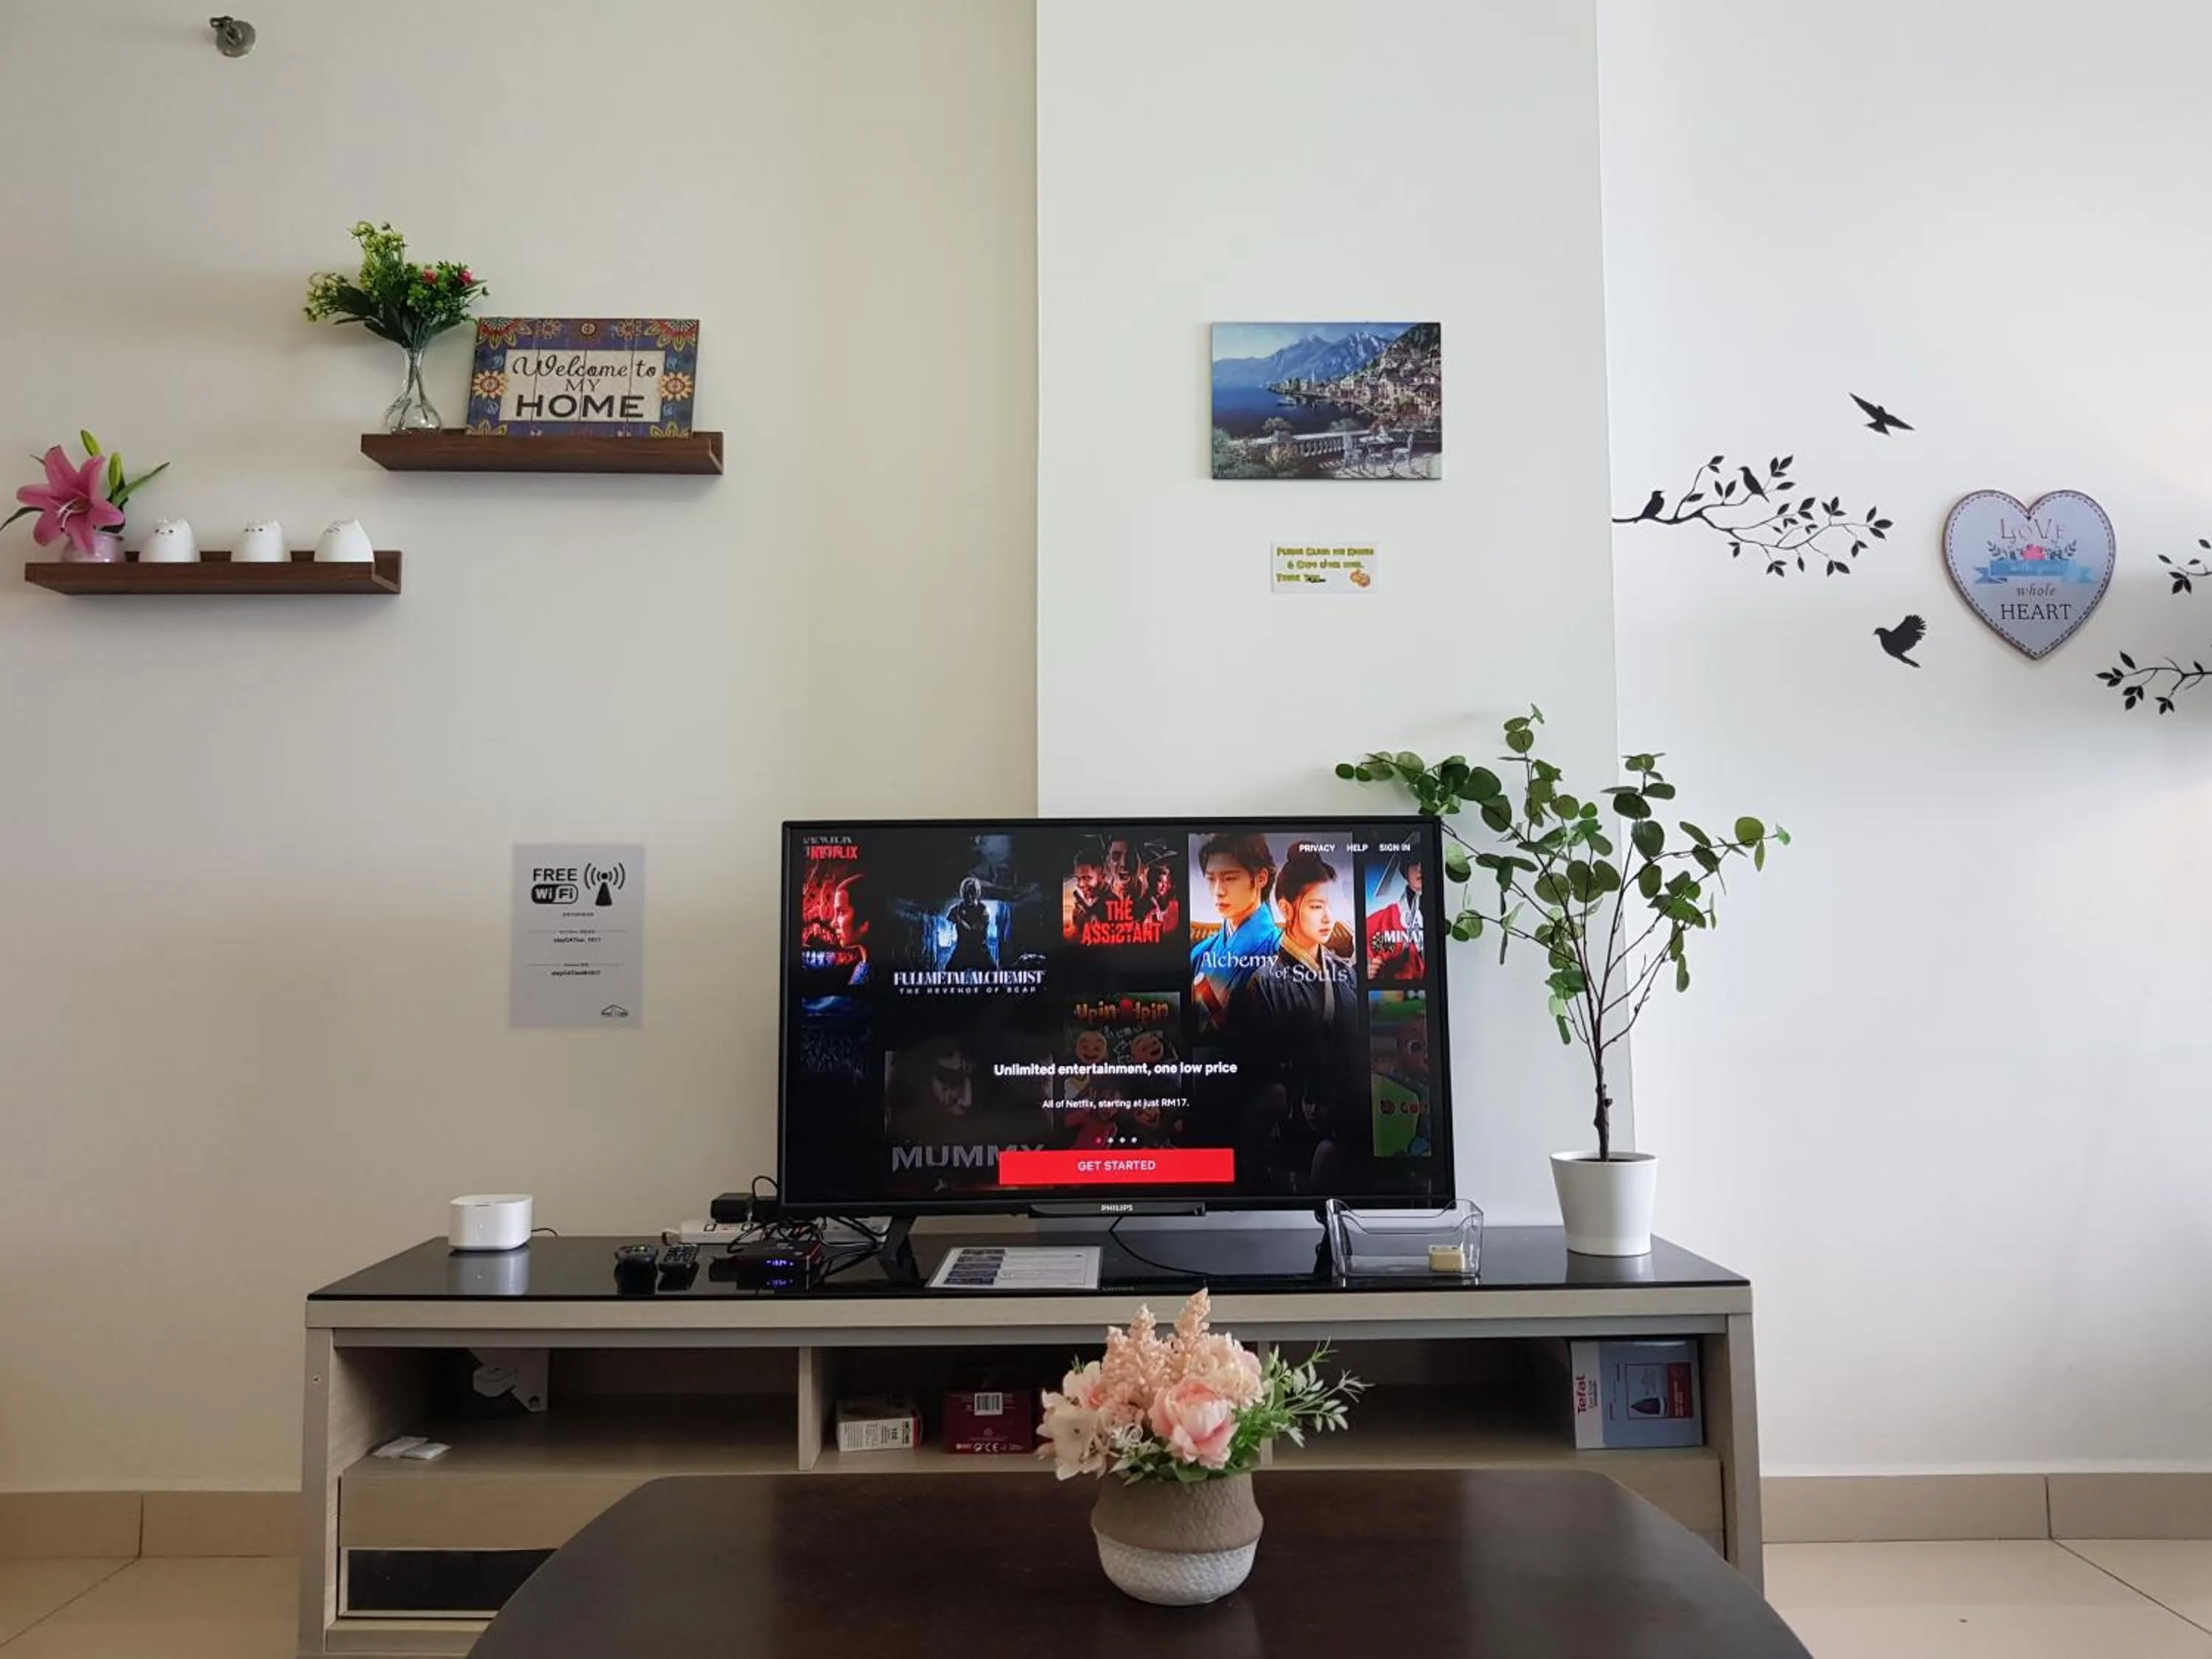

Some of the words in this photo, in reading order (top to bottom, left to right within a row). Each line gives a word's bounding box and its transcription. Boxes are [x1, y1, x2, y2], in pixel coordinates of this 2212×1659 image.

[512, 355, 627, 378] Welcome
[636, 359, 657, 378] to
[564, 378, 601, 392] MY
[515, 394, 644, 418] HOME
[2000, 518, 2066, 540] LOVE
[2016, 582, 2056, 597] whole
[2000, 603, 2073, 620] HEART
[1298, 844, 1335, 852] PRIVACY
[1346, 844, 1369, 852] HELP
[1380, 843, 1399, 852] SIGN
[1401, 843, 1411, 852] IN
[532, 868, 578, 882] FREE
[1105, 899, 1133, 921] THE
[1201, 950, 1279, 975] Alchemy
[1275, 965, 1290, 979] of
[1292, 964, 1349, 983] Souls
[994, 1062, 1055, 1076] Unlimited
[1058, 1062, 1152, 1077] entertainment,
[1154, 1063, 1178, 1074] one
[1180, 1062, 1203, 1074] low
[1206, 1061, 1238, 1077] price
[1042, 1099, 1054, 1108] All
[1055, 1099, 1065, 1108] of
[1065, 1099, 1097, 1110] Netflix,
[1098, 1099, 1132, 1110] starting
[1133, 1099, 1142, 1107] at
[1144, 1099, 1160, 1109] just
[1161, 1098, 1190, 1107] RM17.
[1077, 1161, 1102, 1172] GET
[1104, 1160, 1157, 1171] STARTED
[1575, 1374, 1587, 1416] Tefal
